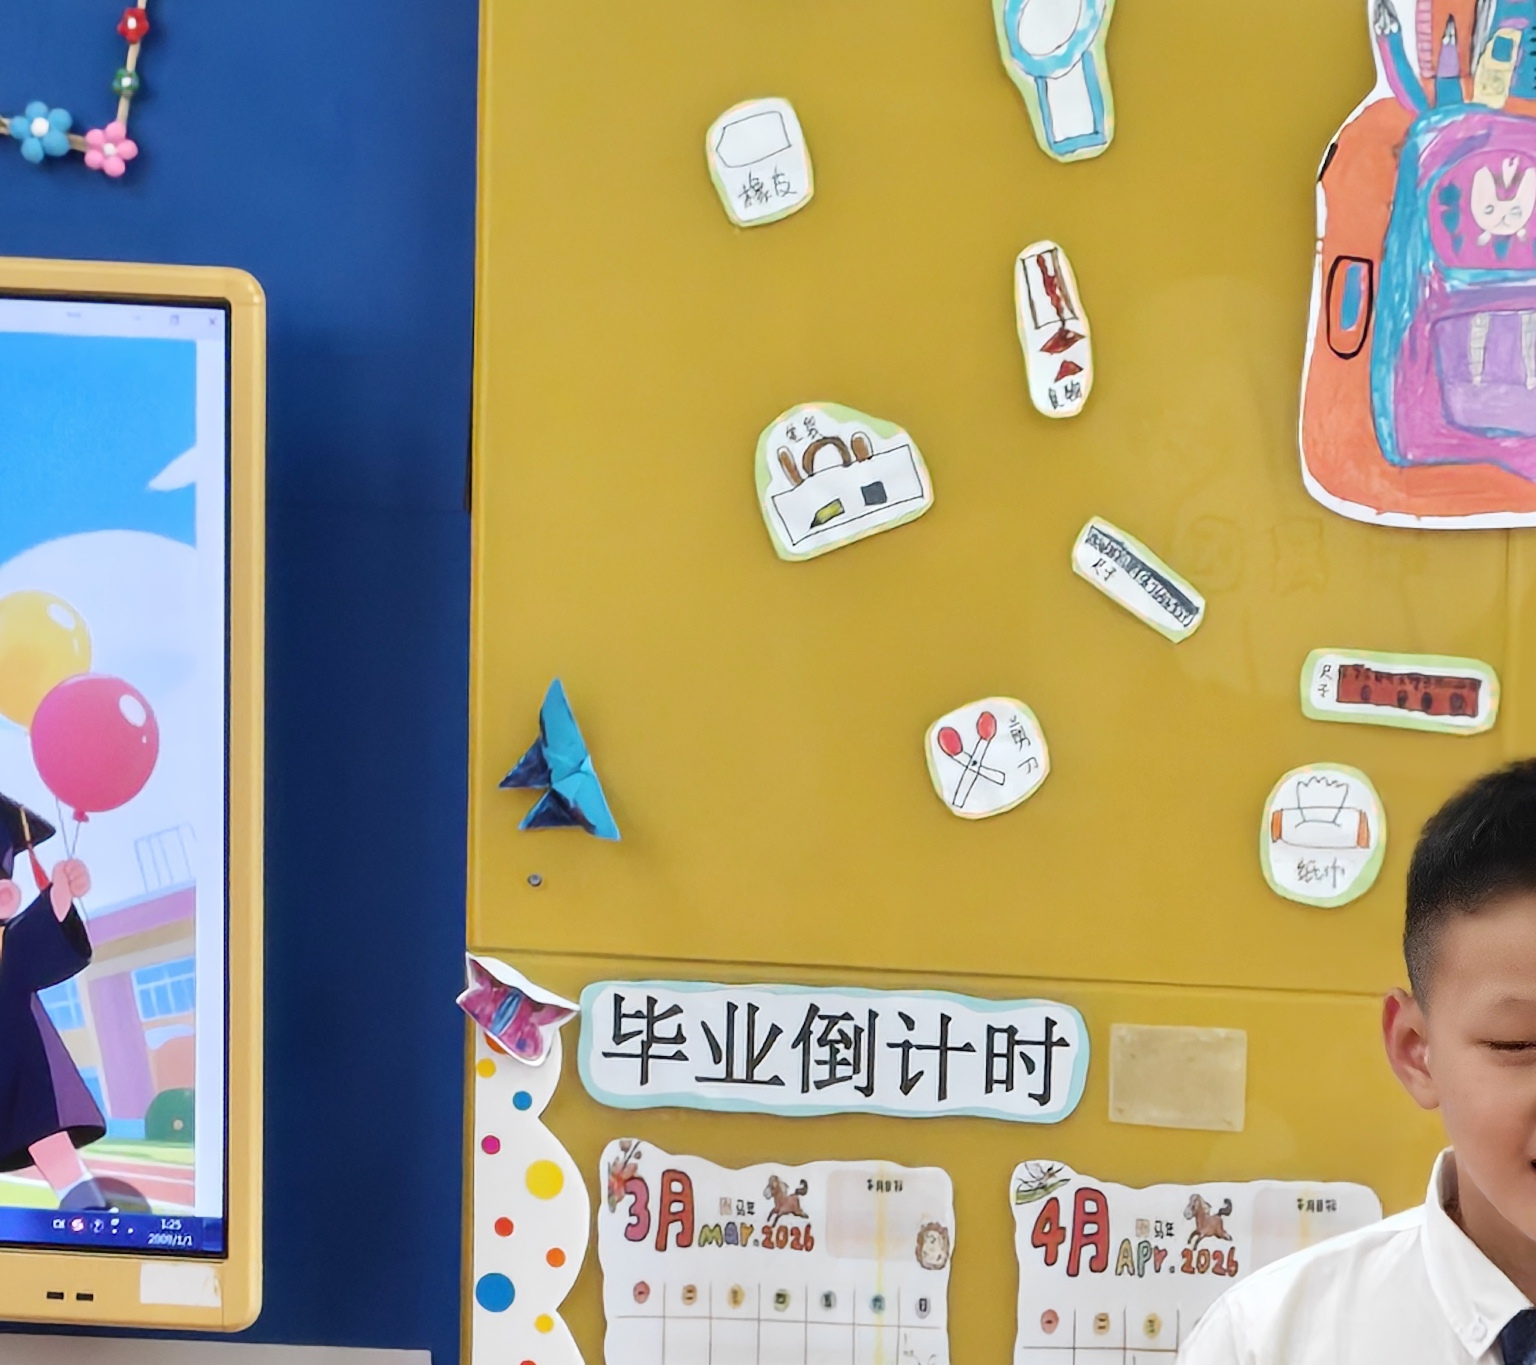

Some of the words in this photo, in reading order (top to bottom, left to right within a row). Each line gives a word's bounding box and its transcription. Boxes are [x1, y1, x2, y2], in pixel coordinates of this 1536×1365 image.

[601, 993, 1071, 1106] 毕业倒计时
[624, 1169, 694, 1252] 3月
[762, 1223, 816, 1252] 2026
[1031, 1187, 1110, 1278] 4月
[1181, 1246, 1239, 1278] 2026
